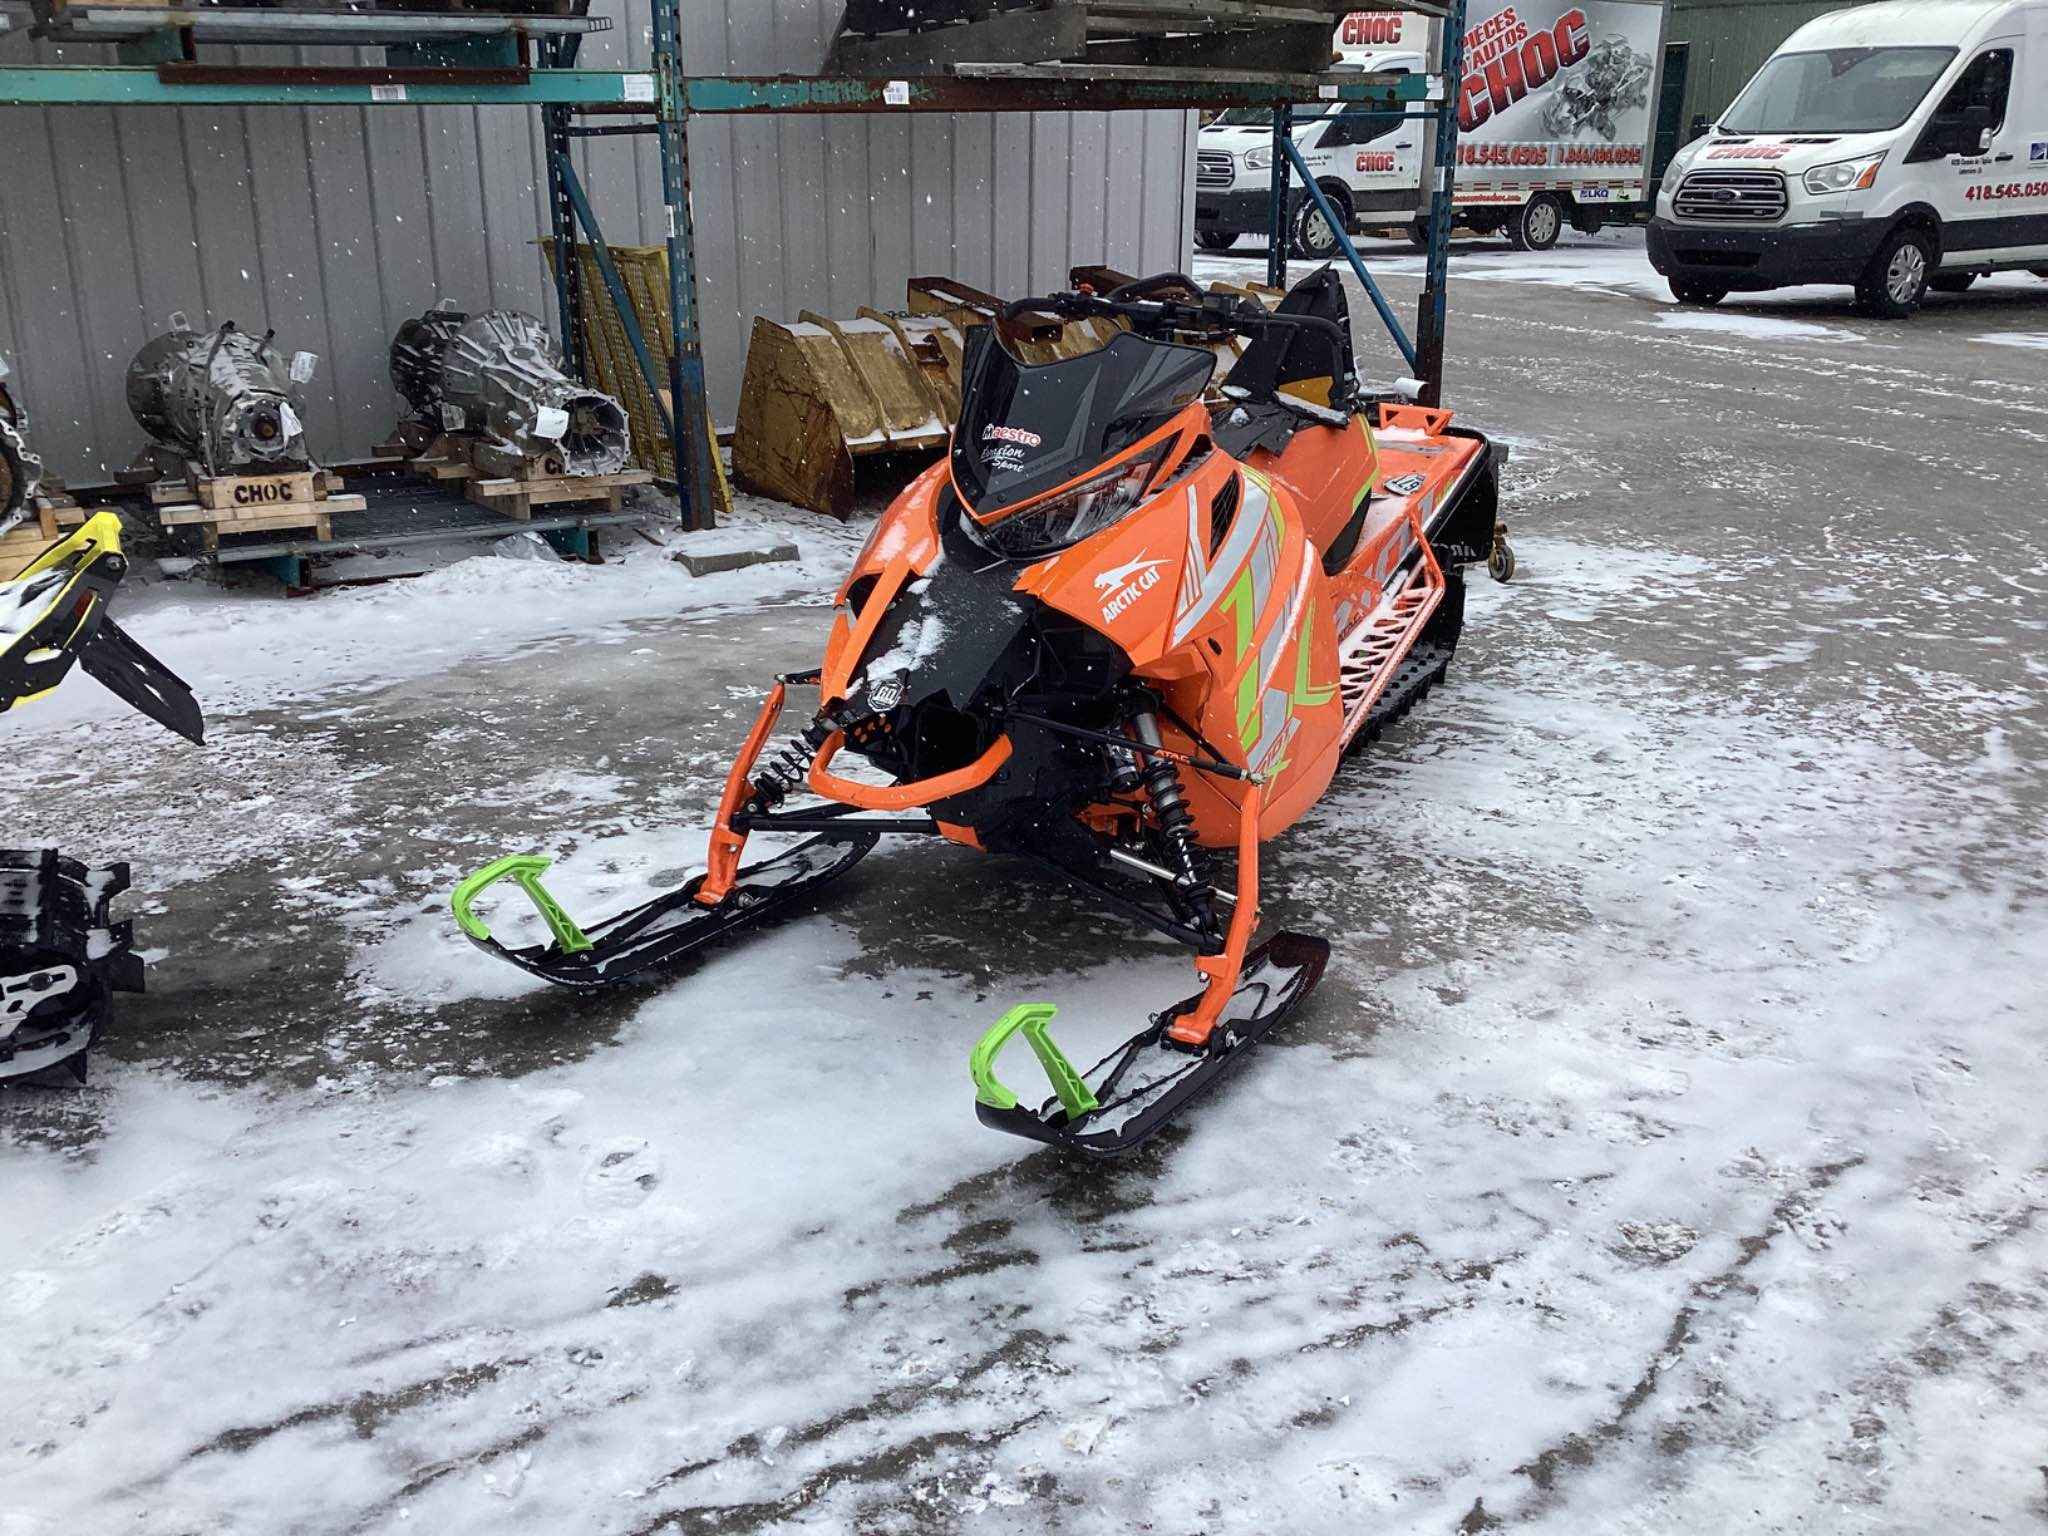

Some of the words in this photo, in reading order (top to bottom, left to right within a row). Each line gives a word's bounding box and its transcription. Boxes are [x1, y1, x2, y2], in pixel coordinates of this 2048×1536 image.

[1342, 17, 1402, 45] CHOC
[1458, 9, 1591, 133] CHOC
[1356, 155, 1394, 172] CHOC
[1457, 144, 1547, 166] 18.545.0505
[982, 423, 1041, 448] Maestro
[234, 483, 293, 504] CHOC
[1102, 581, 1143, 625] ARCTIC
[1138, 565, 1160, 591] CAT
